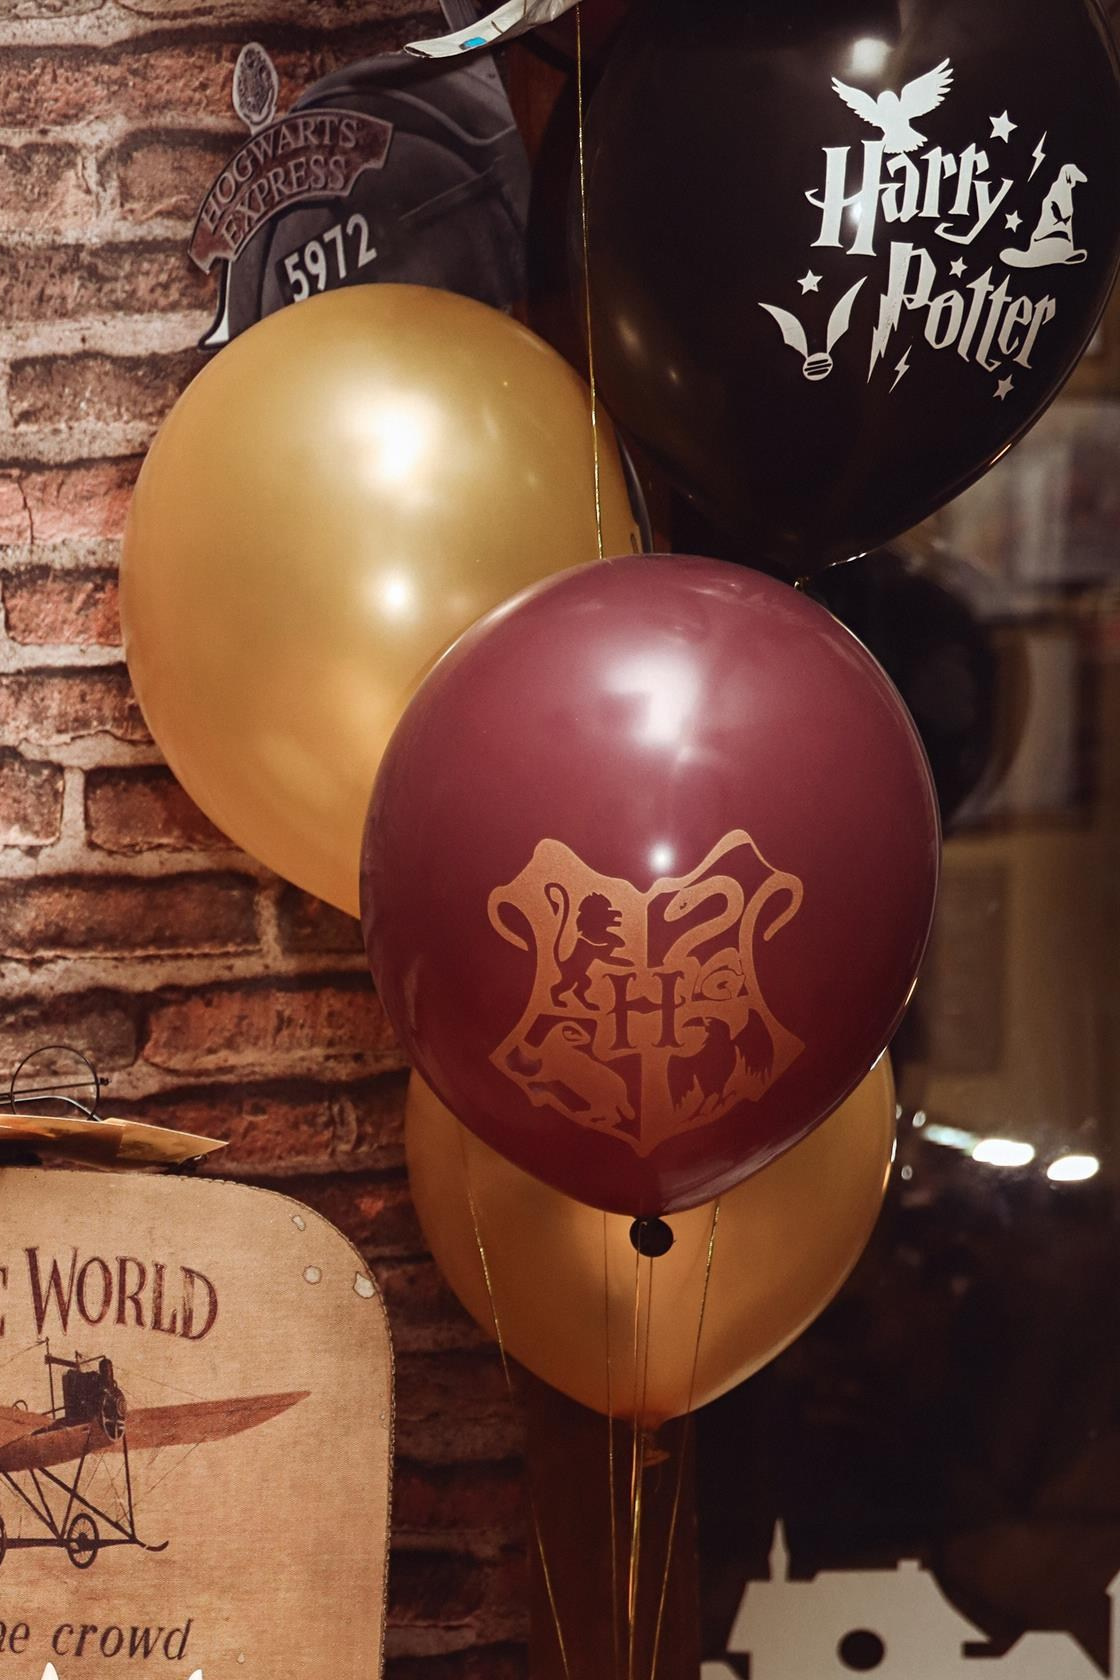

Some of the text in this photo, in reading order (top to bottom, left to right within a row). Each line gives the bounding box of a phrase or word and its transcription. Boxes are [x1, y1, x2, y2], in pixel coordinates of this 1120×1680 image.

[200, 117, 359, 233] HOGWARTS
[221, 154, 349, 249] EXPRESS
[804, 139, 1014, 257] Harry
[283, 212, 378, 303] 5972
[867, 241, 1056, 384] Potter
[50, 1617, 195, 1662] crowd
